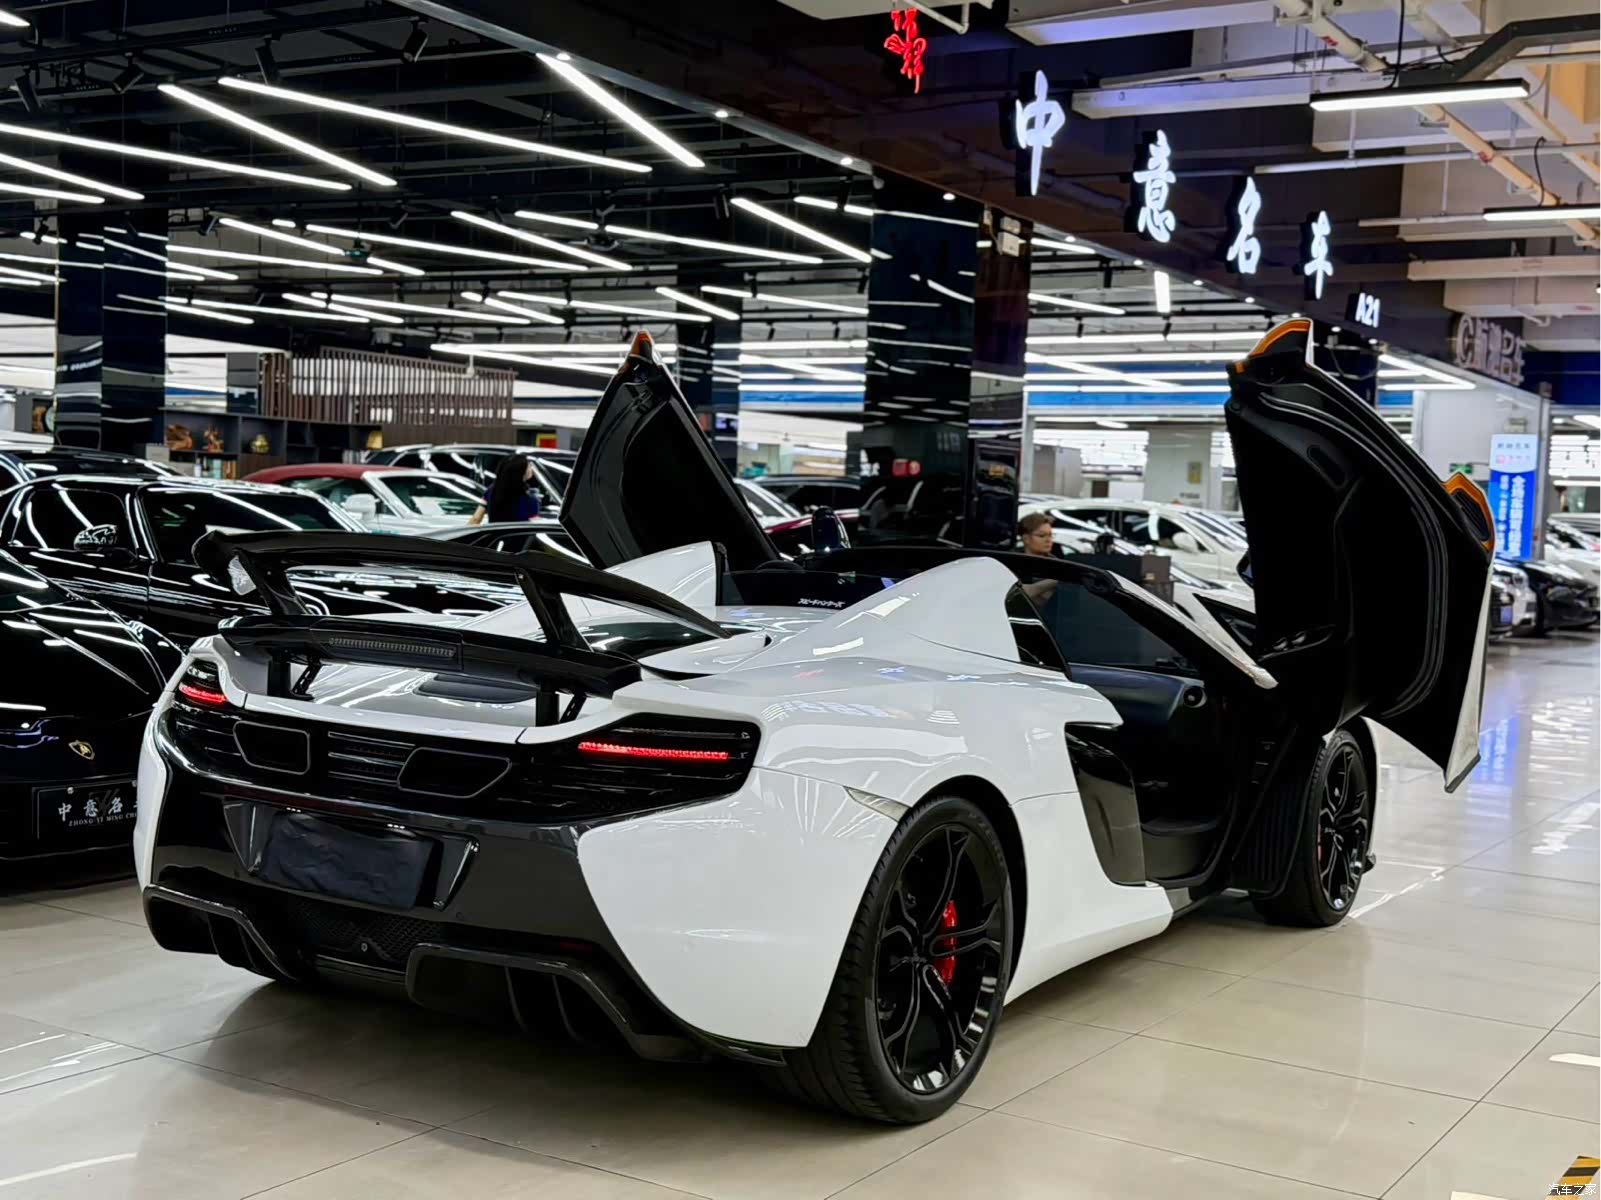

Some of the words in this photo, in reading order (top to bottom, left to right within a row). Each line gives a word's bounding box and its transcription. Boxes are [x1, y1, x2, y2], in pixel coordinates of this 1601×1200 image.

[1015, 69, 1334, 299] 中意名车
[1355, 292, 1380, 328] A21
[58, 797, 137, 822] 中意名
